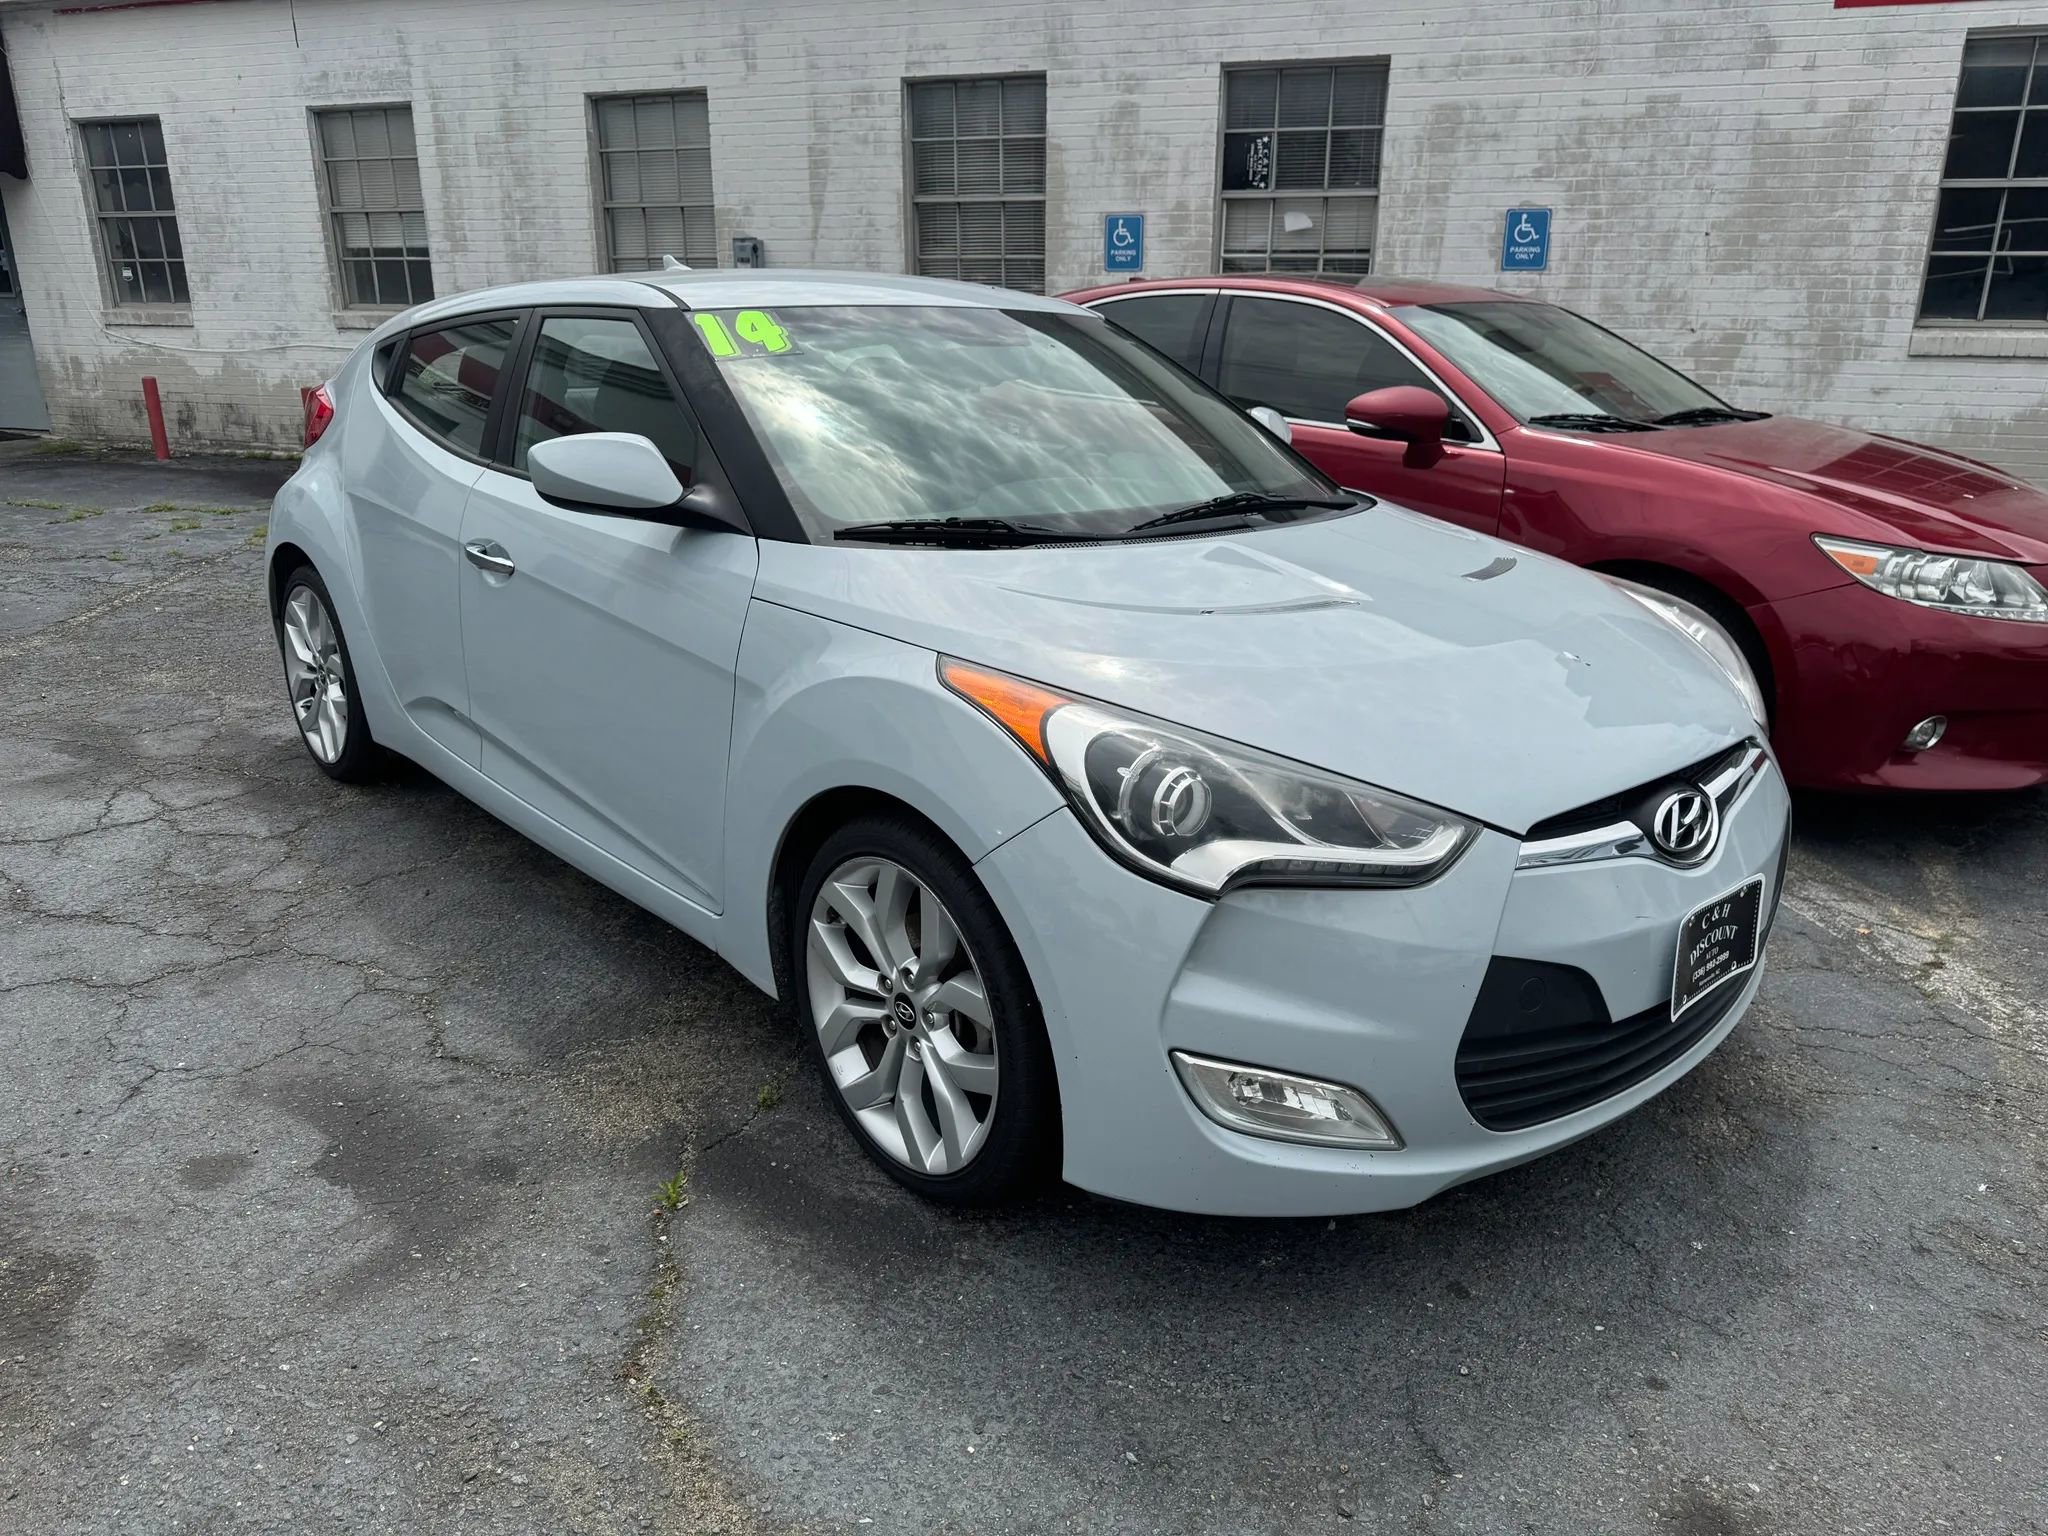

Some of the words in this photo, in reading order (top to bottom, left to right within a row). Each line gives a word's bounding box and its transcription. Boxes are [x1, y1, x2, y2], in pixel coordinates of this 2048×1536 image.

[1510, 246, 1540, 254] PARKING
[694, 310, 792, 356] 14
[1701, 913, 1710, 930] C
[1711, 905, 1721, 921] &
[1721, 903, 1731, 919] H
[1690, 925, 1738, 966] DISCOUNT
